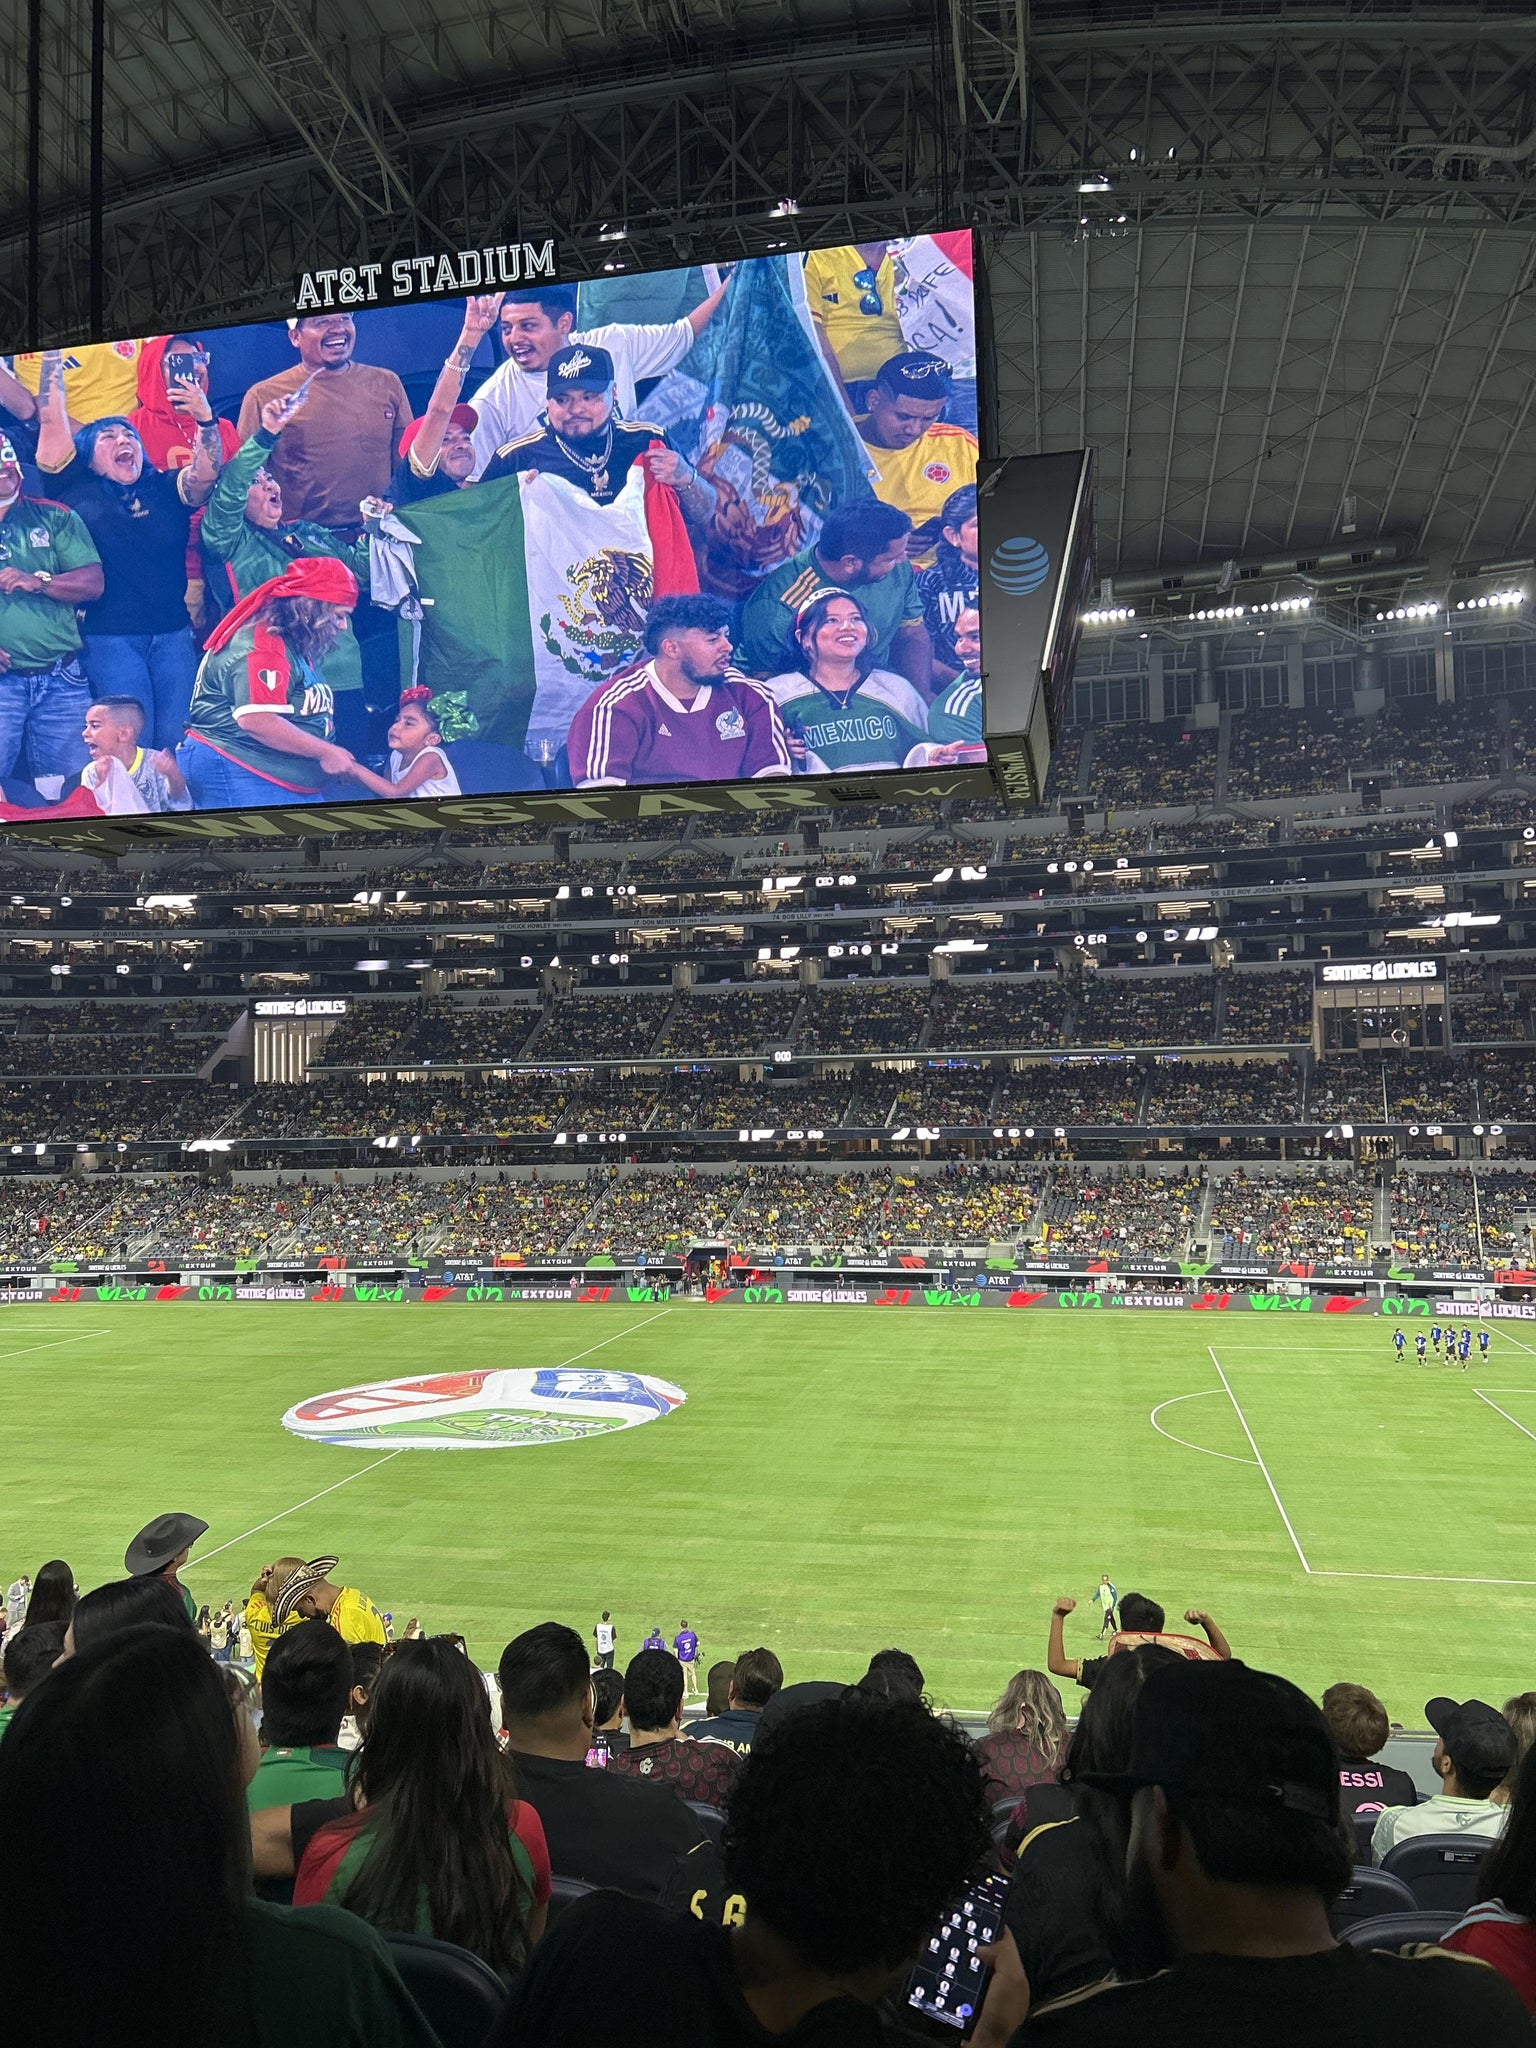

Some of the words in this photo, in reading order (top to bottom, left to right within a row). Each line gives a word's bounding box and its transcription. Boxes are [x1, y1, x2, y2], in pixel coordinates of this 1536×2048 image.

[296, 263, 382, 310] AT&T
[391, 239, 556, 297] STADIUM
[803, 715, 897, 749] MEXICO
[997, 751, 1031, 799] WINSTAR
[155, 787, 829, 838] WINSTAR
[1404, 877, 1422, 885] TOM
[1424, 875, 1455, 883] LANDRY
[1252, 887, 1281, 895] JORDAN
[454, 1273, 475, 1281] AT&T
[988, 1276, 1010, 1285] AT&T
[0, 1291, 43, 1300] XTOUR
[275, 1288, 306, 1299] LOCALES
[511, 1290, 572, 1298] MEXTOUR
[833, 1291, 868, 1303] LOCALES
[1111, 1296, 1184, 1306] MEXTOUR
[1493, 1303, 1536, 1319] LOCALES
[254, 1620, 275, 1634] LUIS
[1338, 1771, 1385, 1788] ESSI
